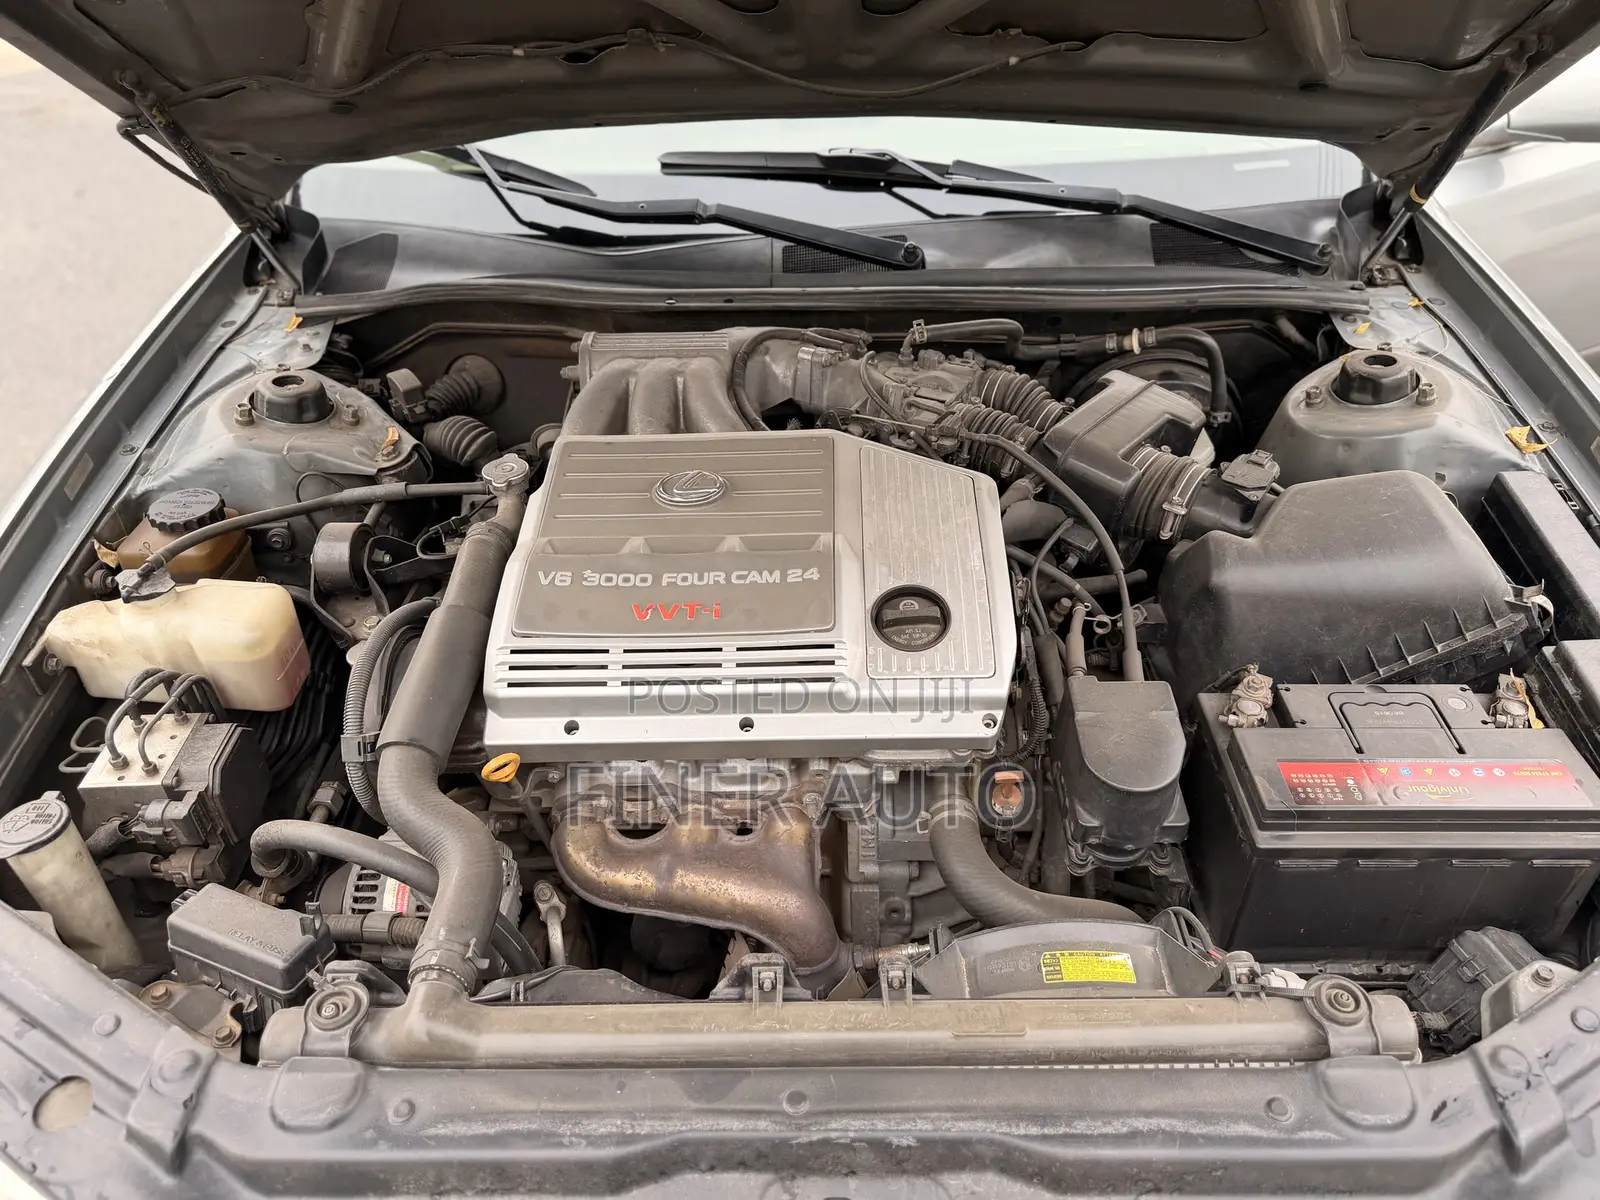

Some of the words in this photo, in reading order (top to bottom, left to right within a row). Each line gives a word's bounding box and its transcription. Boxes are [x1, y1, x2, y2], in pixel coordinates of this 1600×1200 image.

[538, 570, 573, 587] V6
[581, 569, 653, 587] 3000
[661, 571, 727, 587] FOUR
[731, 569, 780, 584] CAM
[786, 567, 820, 583] 24
[631, 601, 721, 621] VVT-i
